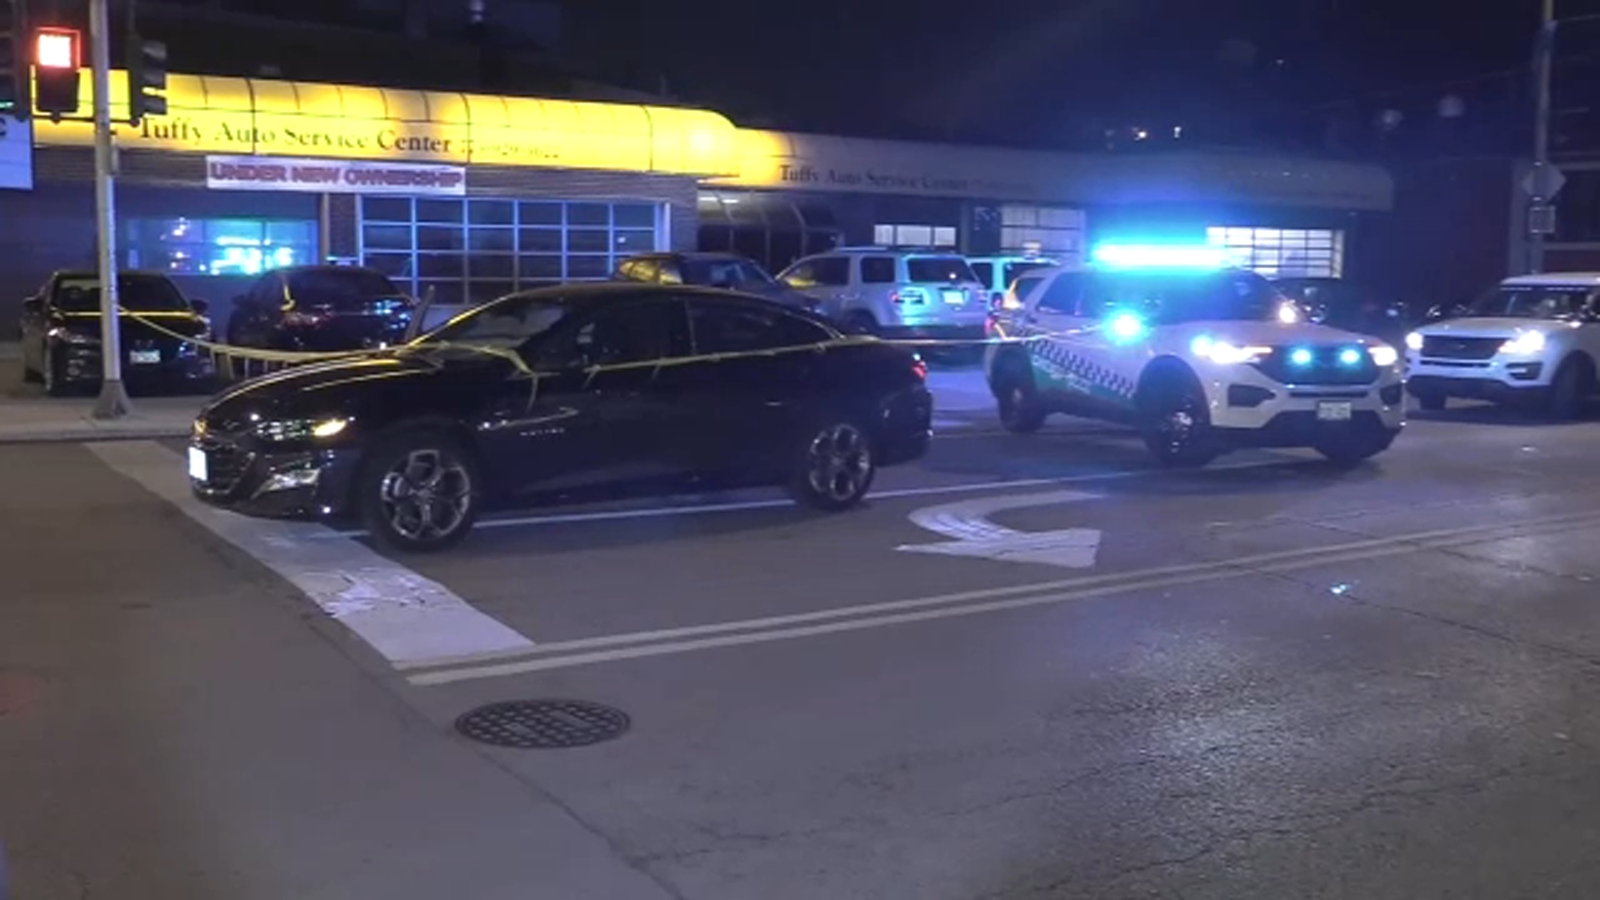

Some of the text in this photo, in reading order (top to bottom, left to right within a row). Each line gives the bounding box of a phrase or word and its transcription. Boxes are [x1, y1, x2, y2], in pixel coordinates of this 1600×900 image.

[139, 118, 202, 146] Tuffy
[215, 121, 276, 144] Auto
[284, 128, 369, 149] Service
[377, 129, 453, 153] Center
[210, 162, 464, 188] UNDER NEW OWNERSHIP
[779, 164, 819, 183] Tuffy
